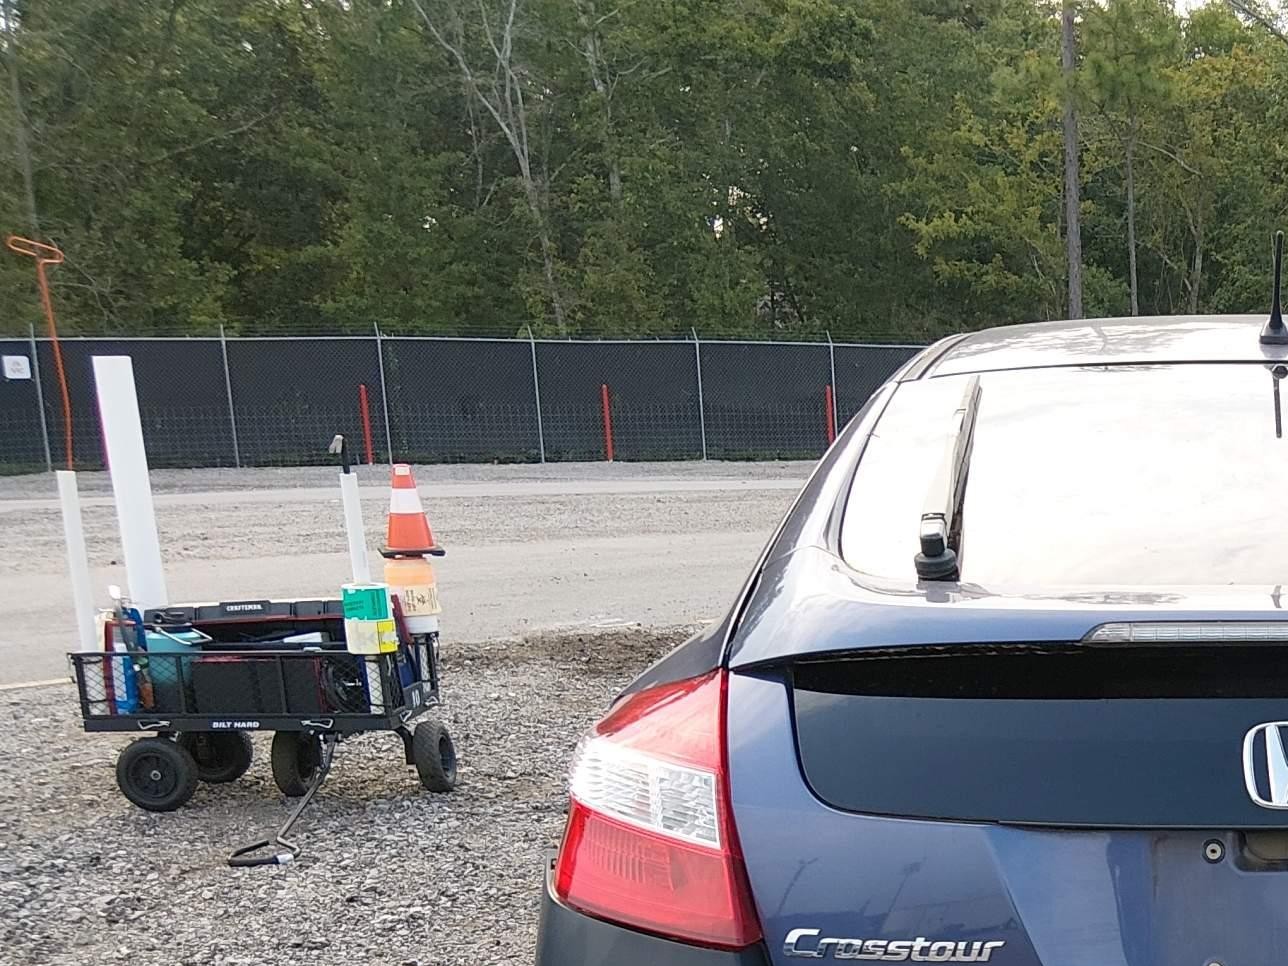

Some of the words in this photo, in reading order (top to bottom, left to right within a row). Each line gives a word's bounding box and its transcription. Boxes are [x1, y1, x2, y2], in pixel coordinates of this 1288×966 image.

[212, 721, 233, 729] BILT
[233, 721, 260, 729] HARD
[783, 927, 1005, 963] Crosstour
